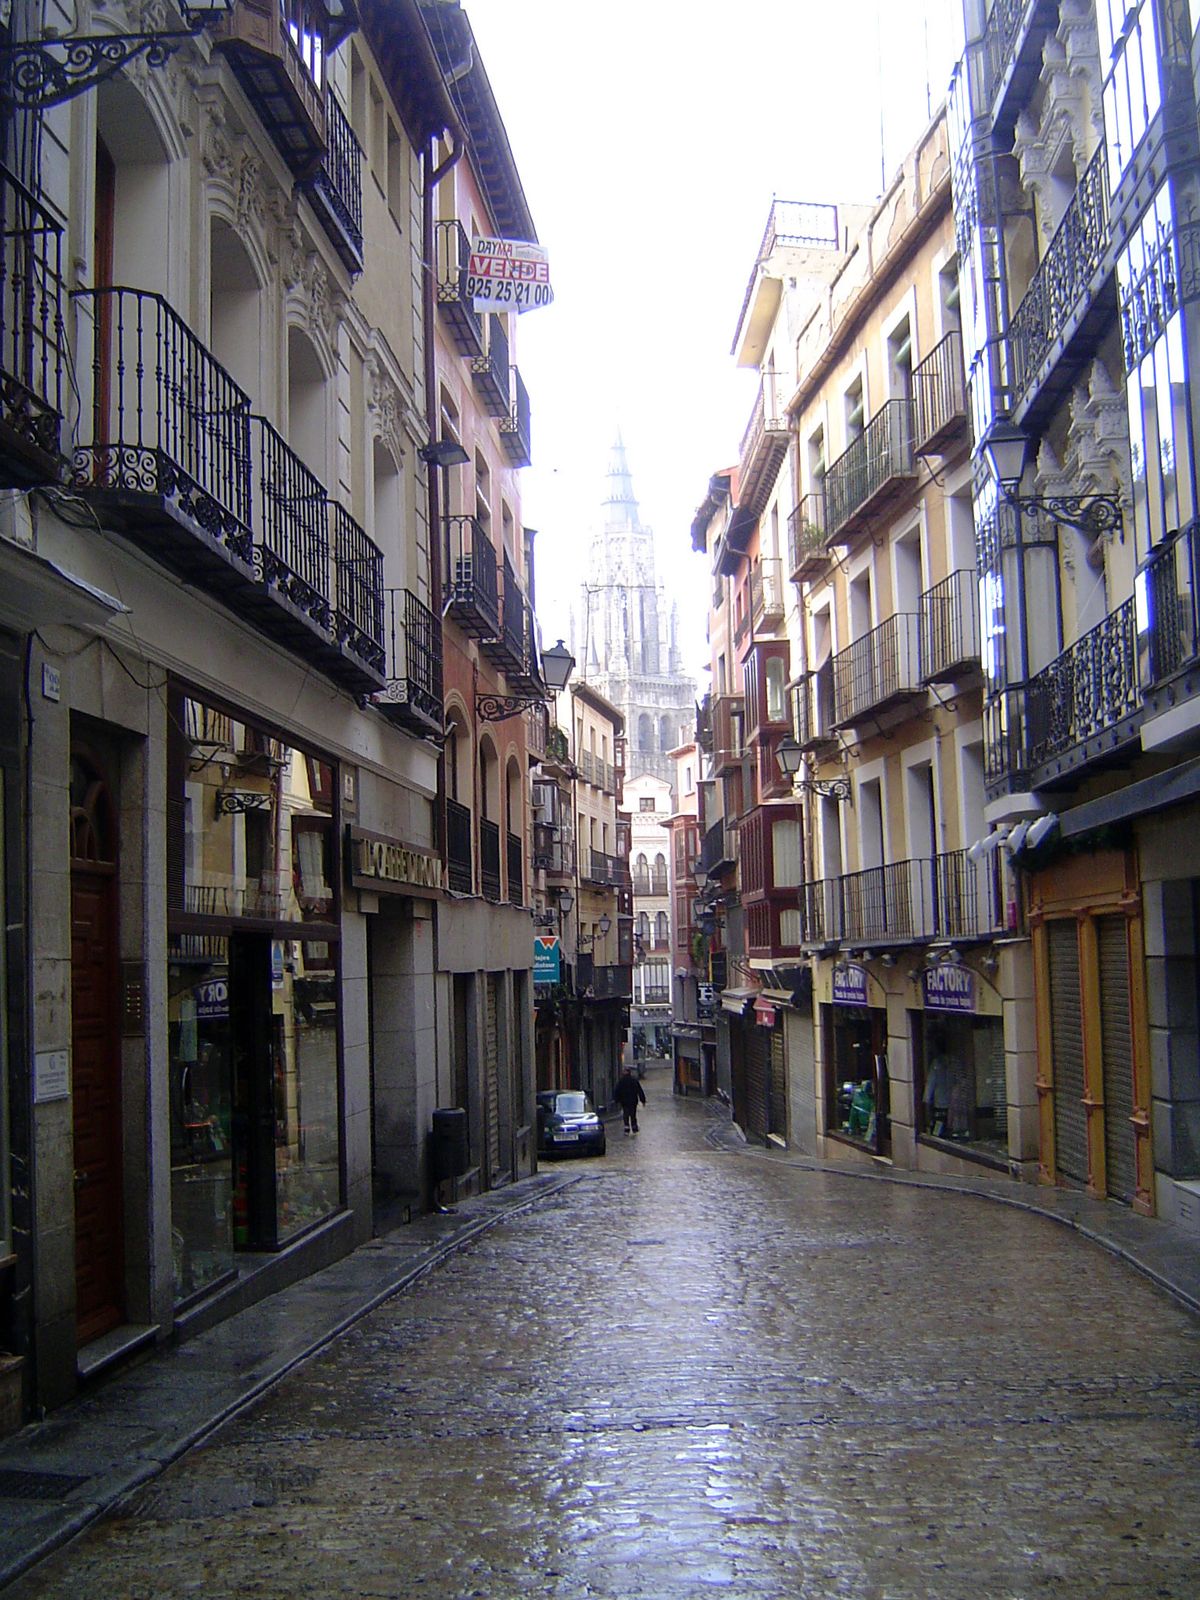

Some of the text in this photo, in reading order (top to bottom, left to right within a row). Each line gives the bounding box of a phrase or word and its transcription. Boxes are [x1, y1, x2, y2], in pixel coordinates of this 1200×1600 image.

[477, 240, 513, 257] DAYMA
[473, 256, 549, 282] VENDE
[467, 277, 549, 305] 925 25 21 00
[927, 966, 971, 992] FACTORY
